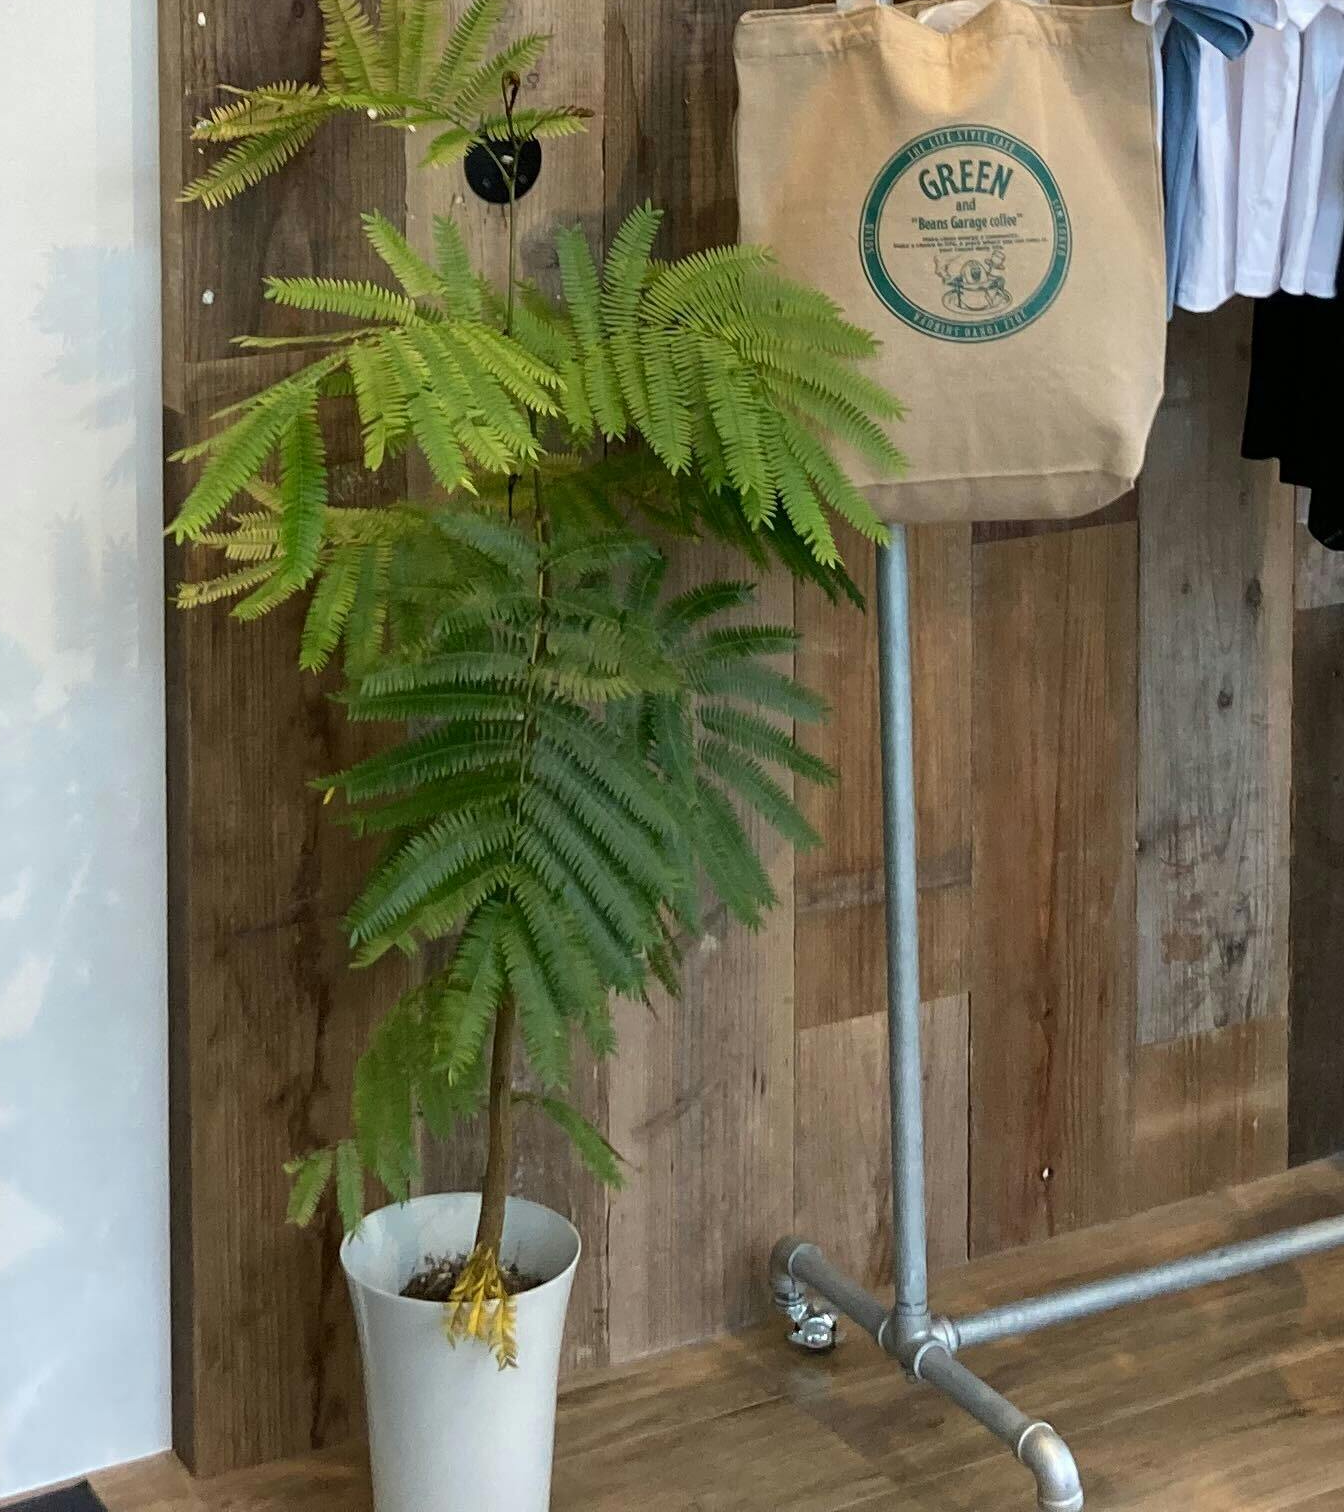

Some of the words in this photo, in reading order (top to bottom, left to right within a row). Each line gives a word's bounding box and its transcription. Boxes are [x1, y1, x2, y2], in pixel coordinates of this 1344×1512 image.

[918, 159, 1014, 201] GREEN
[956, 198, 976, 211] and
[912, 216, 948, 231] "Beans
[950, 215, 988, 231] Garage
[989, 212, 1023, 228] coffee"
